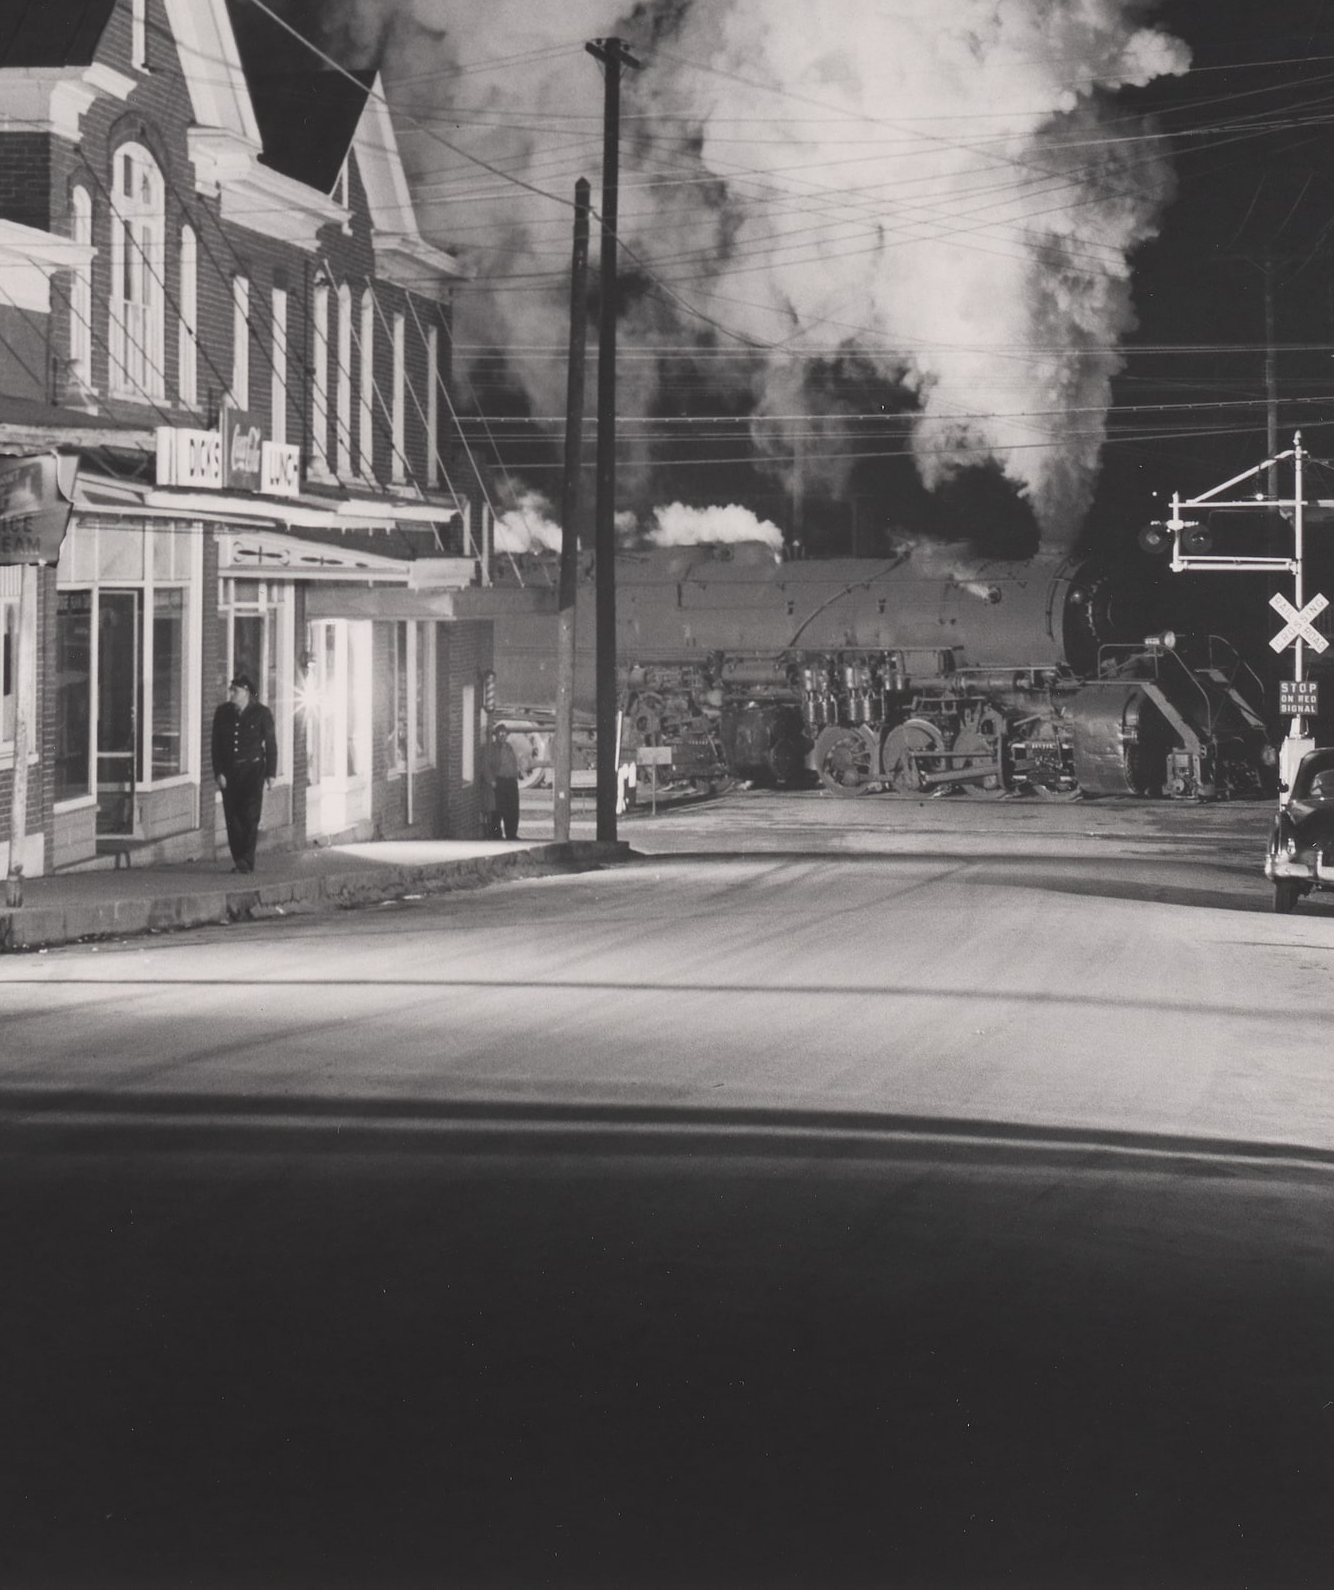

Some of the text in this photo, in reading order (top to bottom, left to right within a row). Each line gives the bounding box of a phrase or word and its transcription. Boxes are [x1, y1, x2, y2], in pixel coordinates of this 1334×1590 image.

[2, 516, 33, 533] ICE
[1280, 683, 1317, 694] STOP
[1280, 695, 1317, 703] ON RED
[1280, 704, 1316, 714] SIGNAL
